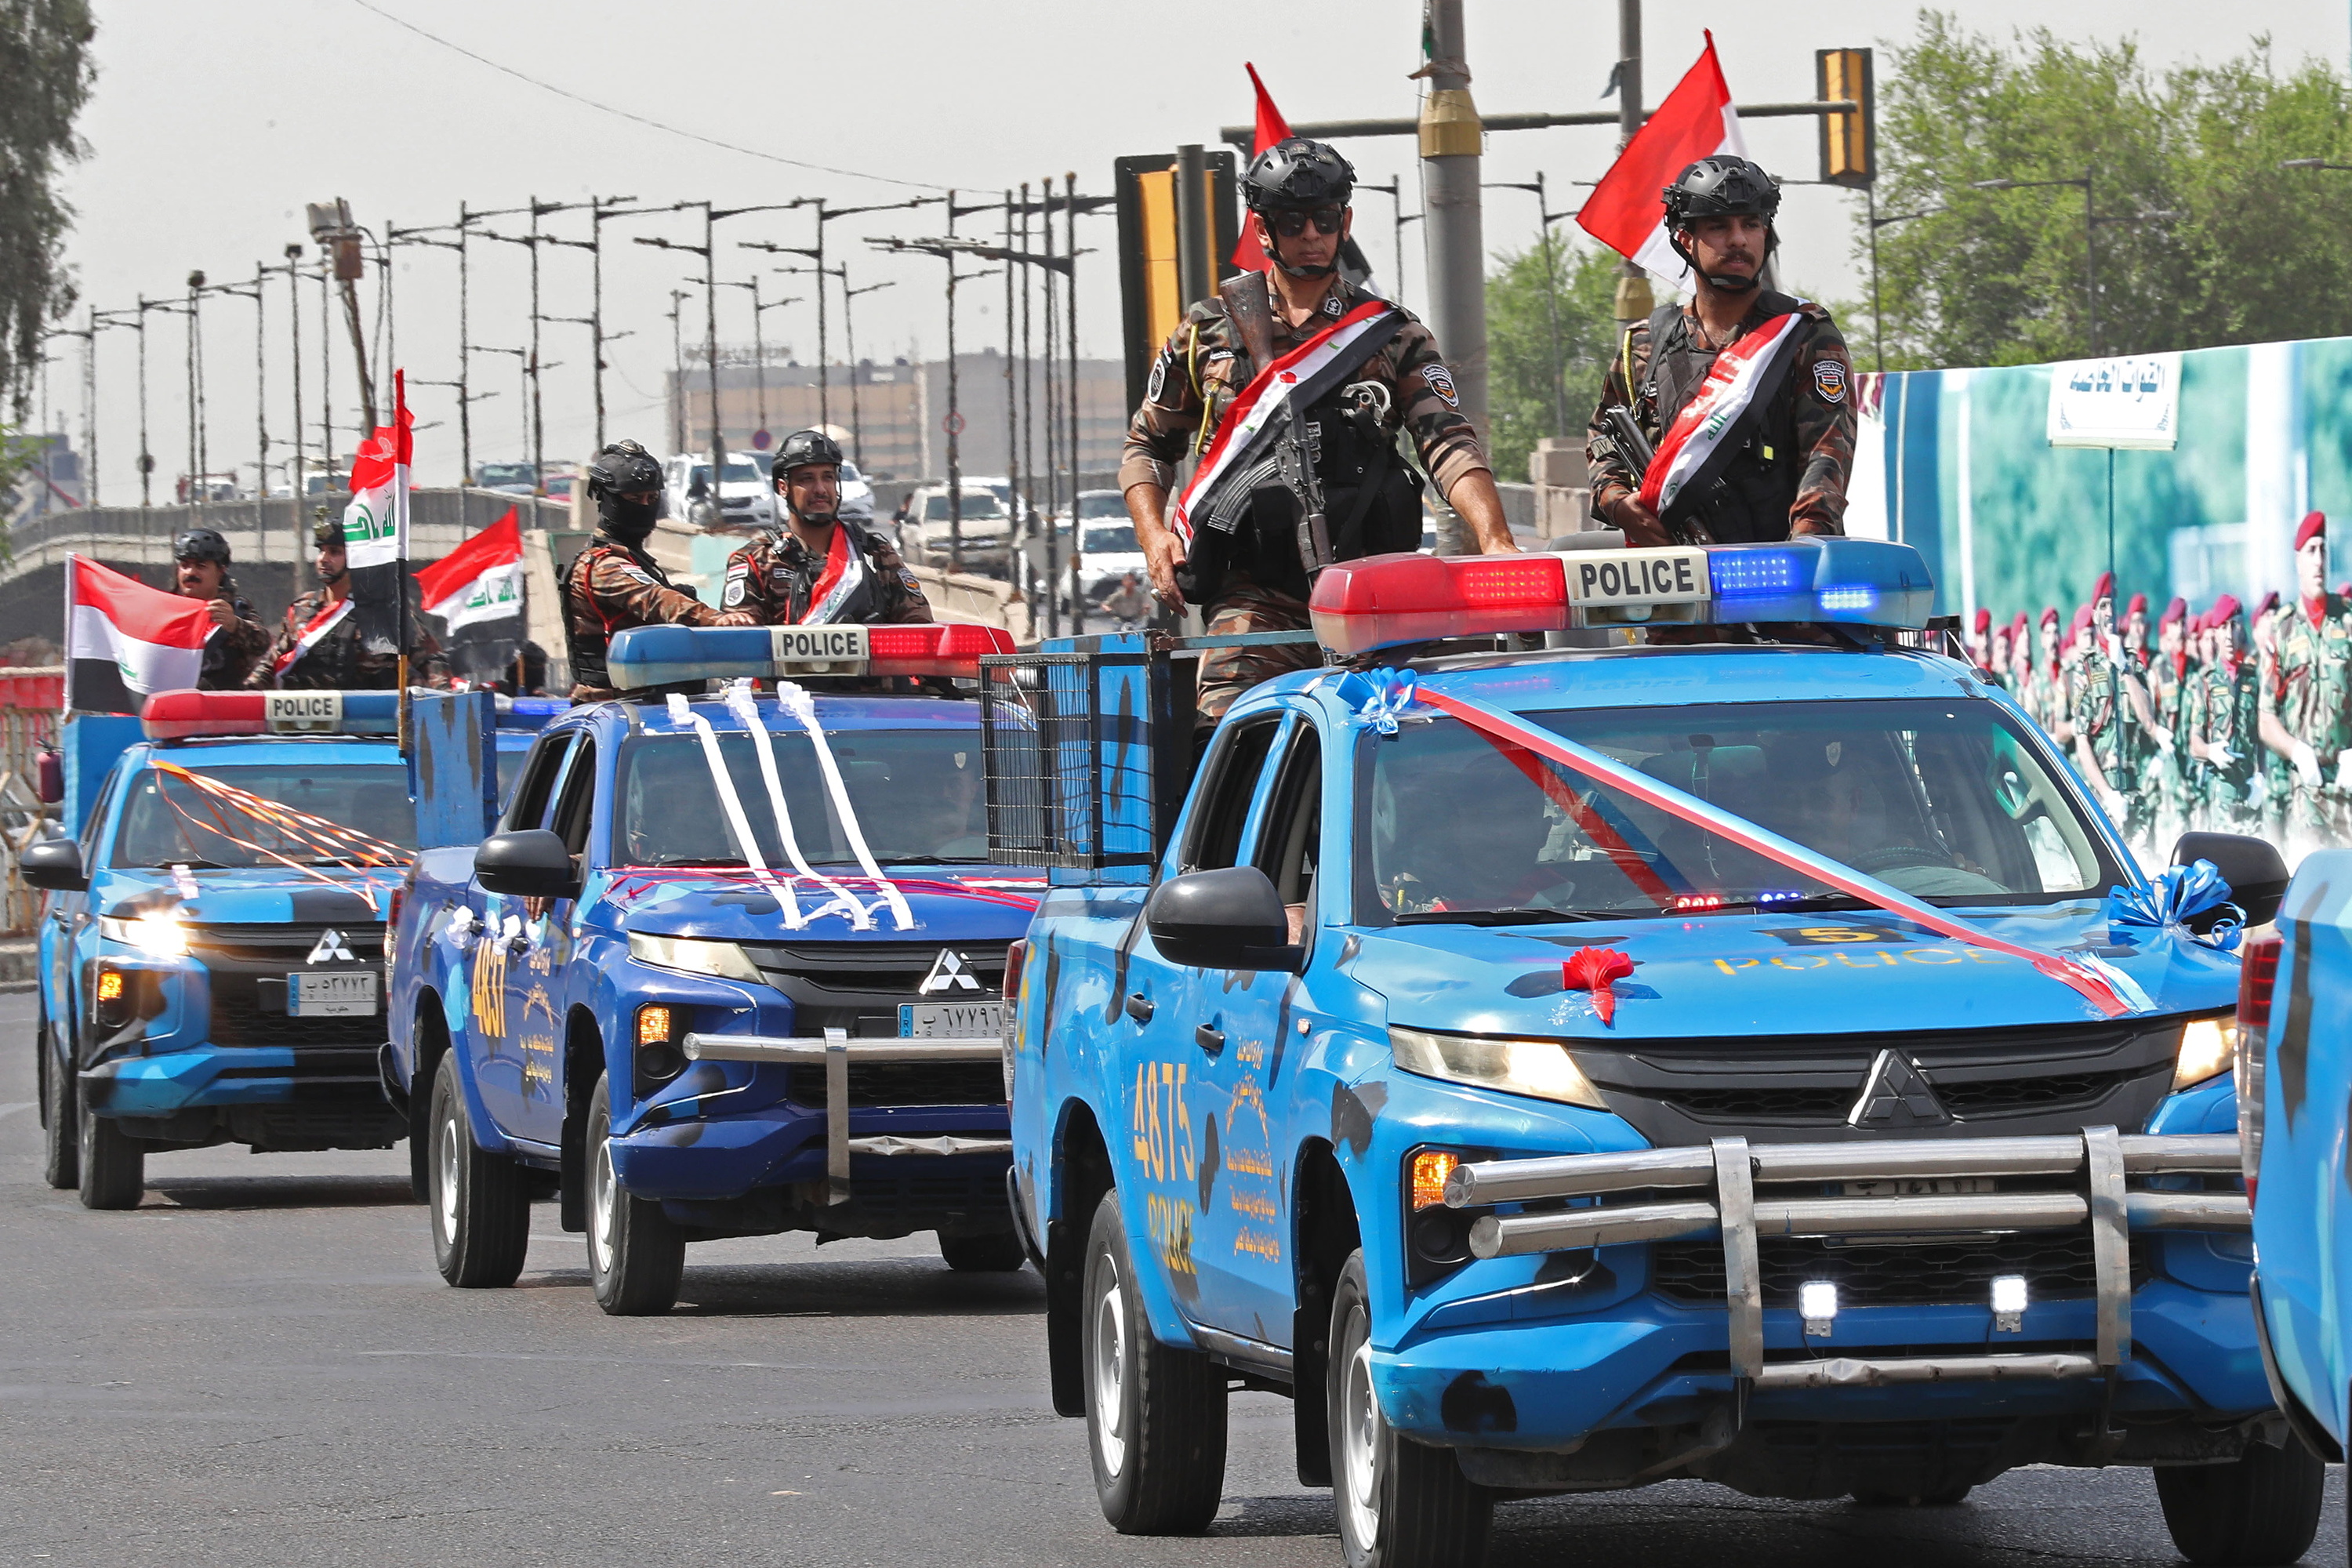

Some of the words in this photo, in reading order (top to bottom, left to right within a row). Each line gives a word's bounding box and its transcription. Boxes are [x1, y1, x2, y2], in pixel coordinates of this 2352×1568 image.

[1580, 557, 1694, 598] POLICE
[782, 633, 858, 656] POLICE
[274, 698, 333, 717] POLICE
[1798, 927, 1880, 943] 5
[1713, 947, 2012, 975] POLICE
[473, 936, 507, 1038] 4837
[923, 1014, 936, 1029] ب
[942, 1007, 1003, 1029] ٦٧٧٩٦
[1134, 1061, 1196, 1184] 4875
[1147, 1192, 1198, 1276] POLICE
